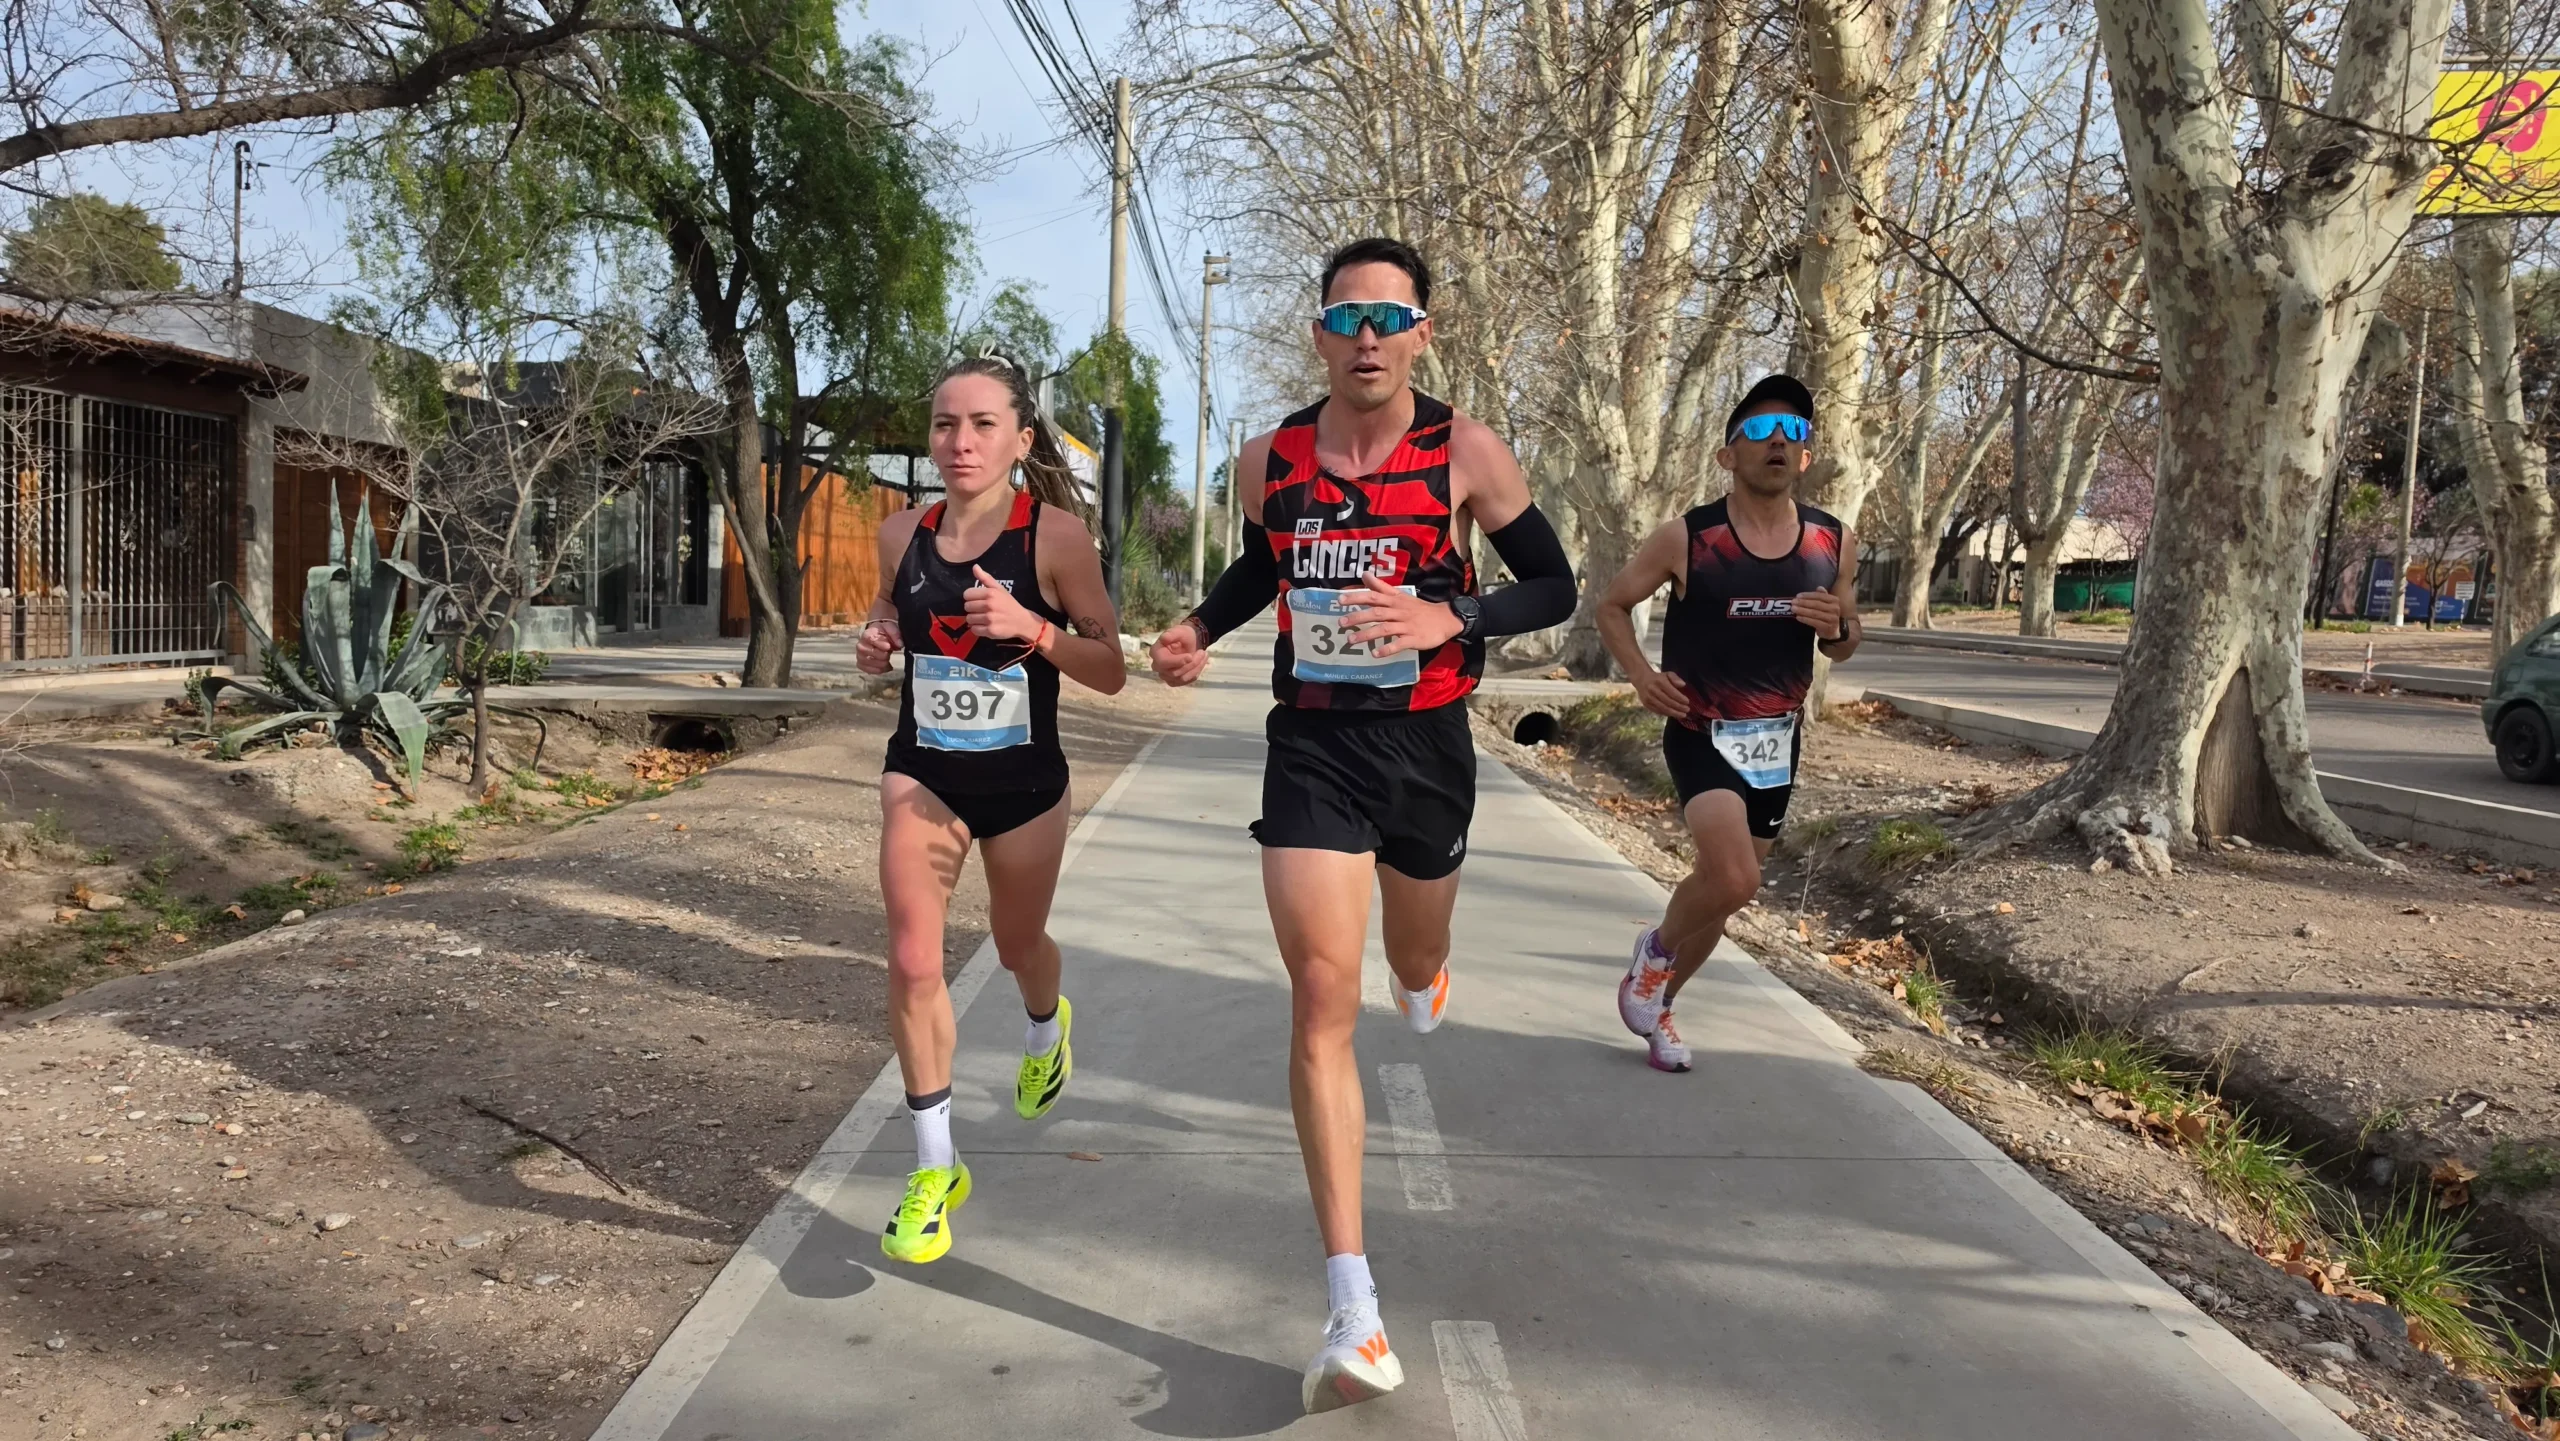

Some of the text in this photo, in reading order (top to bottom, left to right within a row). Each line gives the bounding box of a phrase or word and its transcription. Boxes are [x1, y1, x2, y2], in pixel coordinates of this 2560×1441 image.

[1298, 521, 1319, 535] LOS
[1293, 538, 1399, 579] LINCES
[1730, 600, 1793, 612] PUS
[949, 665, 979, 678] 21K
[930, 690, 1005, 720] 397
[1731, 738, 1779, 764] 342
